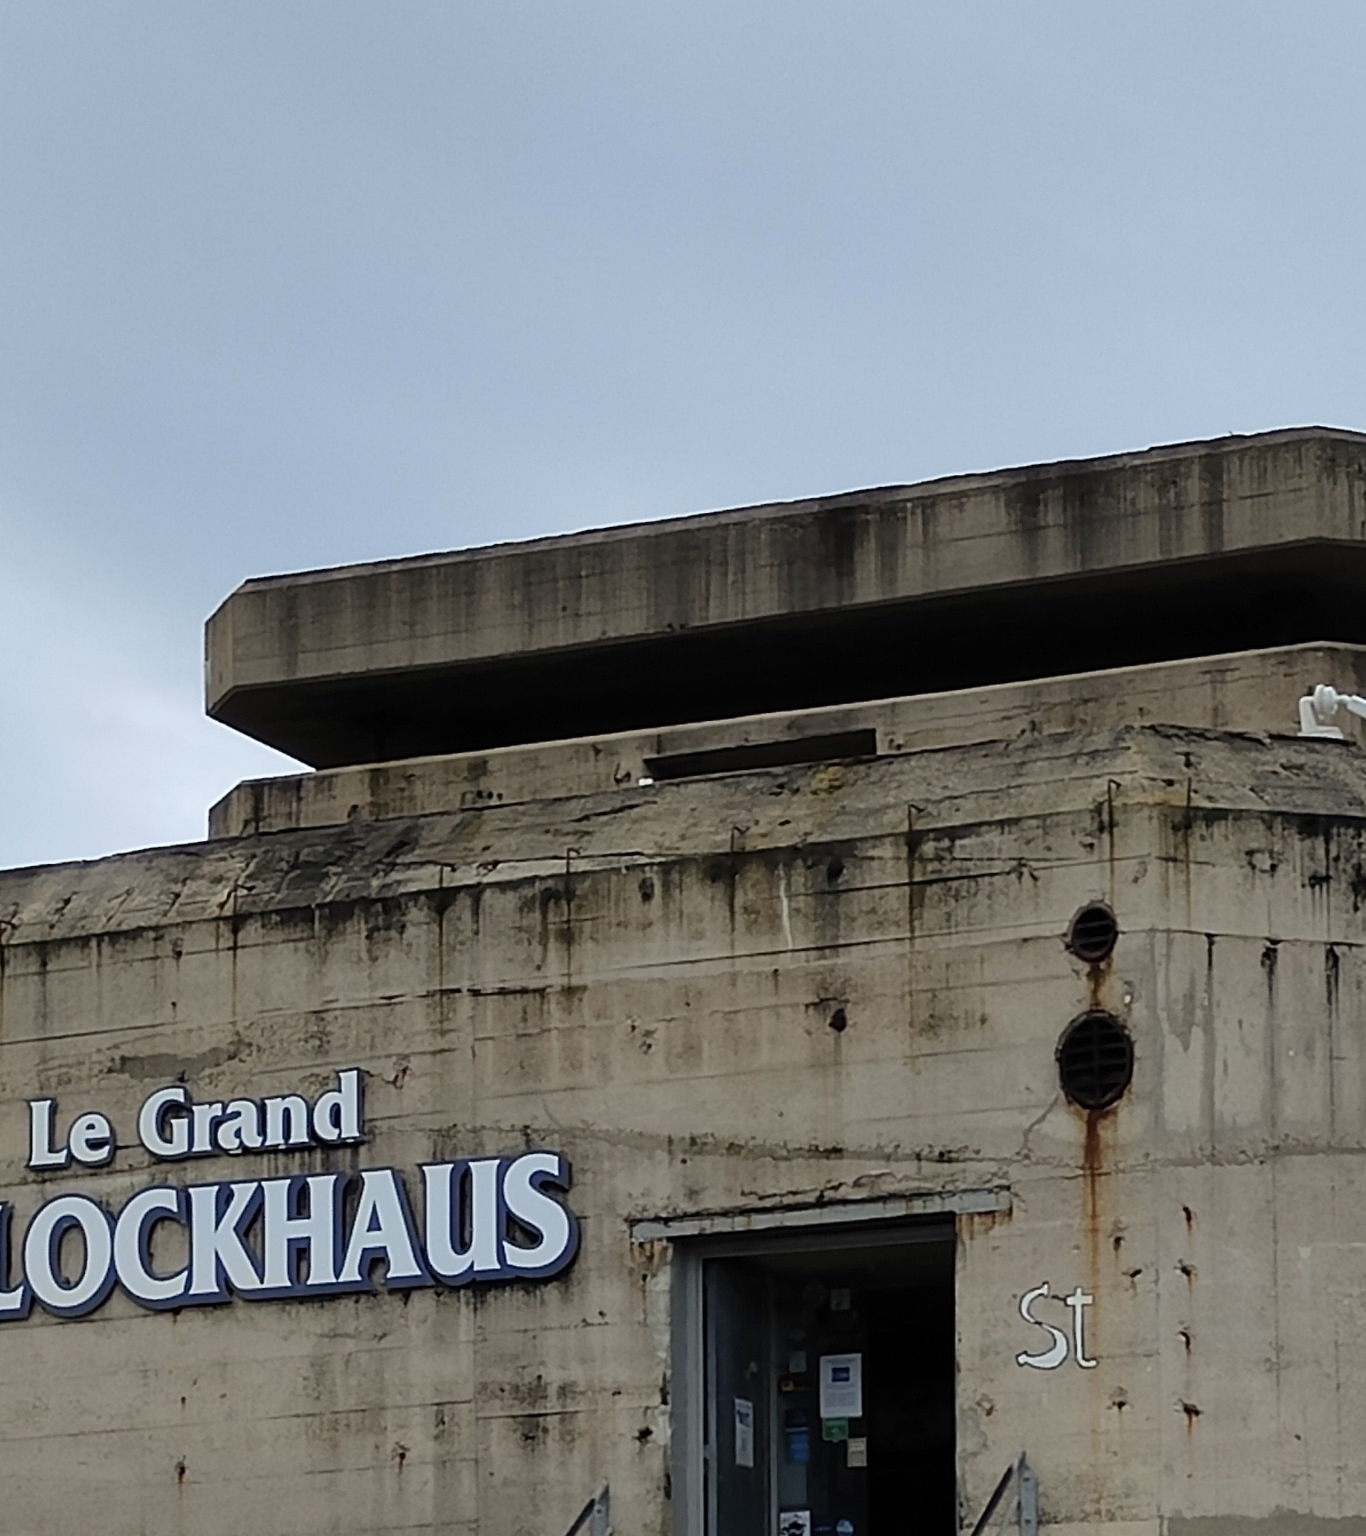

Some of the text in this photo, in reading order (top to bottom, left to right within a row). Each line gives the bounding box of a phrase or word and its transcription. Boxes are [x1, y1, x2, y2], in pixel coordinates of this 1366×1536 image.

[29, 1068, 367, 1168] Le Grand
[1016, 1281, 1098, 1369] St
